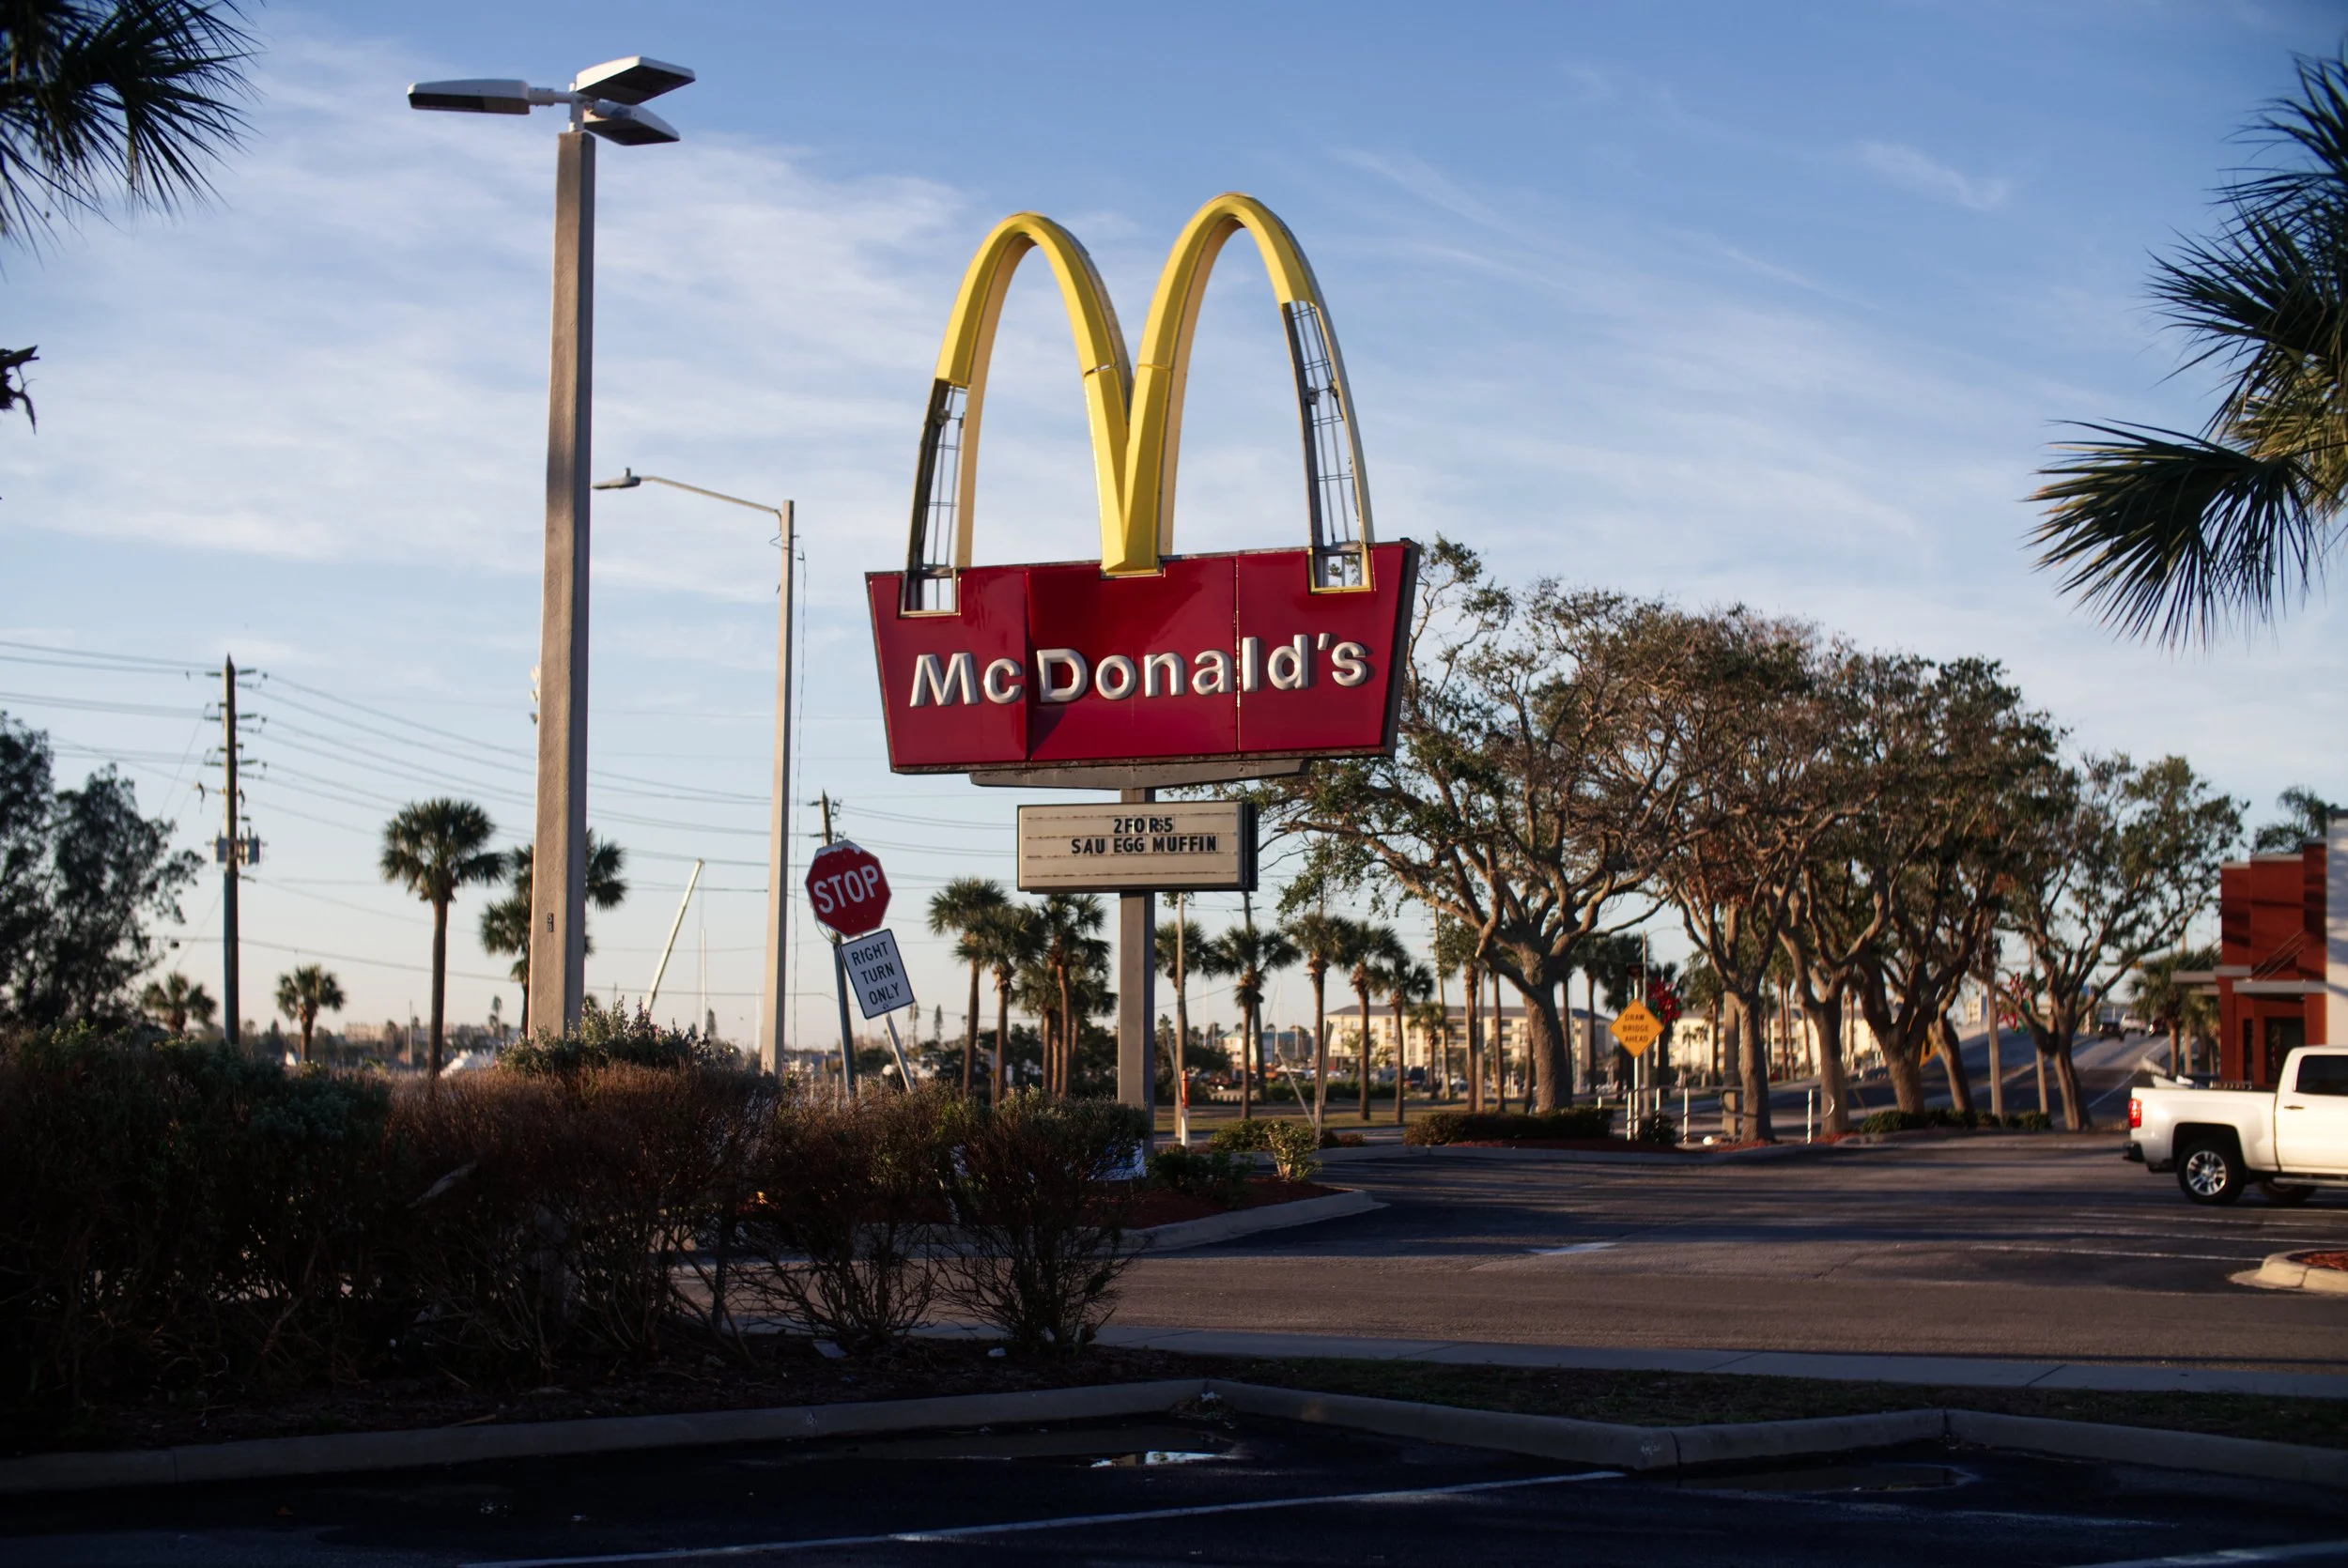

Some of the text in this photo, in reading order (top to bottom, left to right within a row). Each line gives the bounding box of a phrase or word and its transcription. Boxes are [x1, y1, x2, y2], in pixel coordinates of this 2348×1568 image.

[909, 633, 1367, 708] McDonald's
[1114, 818, 1122, 834] 2
[1071, 836, 1217, 854] SAU EGG MUFFIN
[813, 865, 879, 914] STOP
[851, 942, 888, 966] RIGHT
[860, 961, 895, 985] TURN
[869, 983, 900, 1005] ONLY
